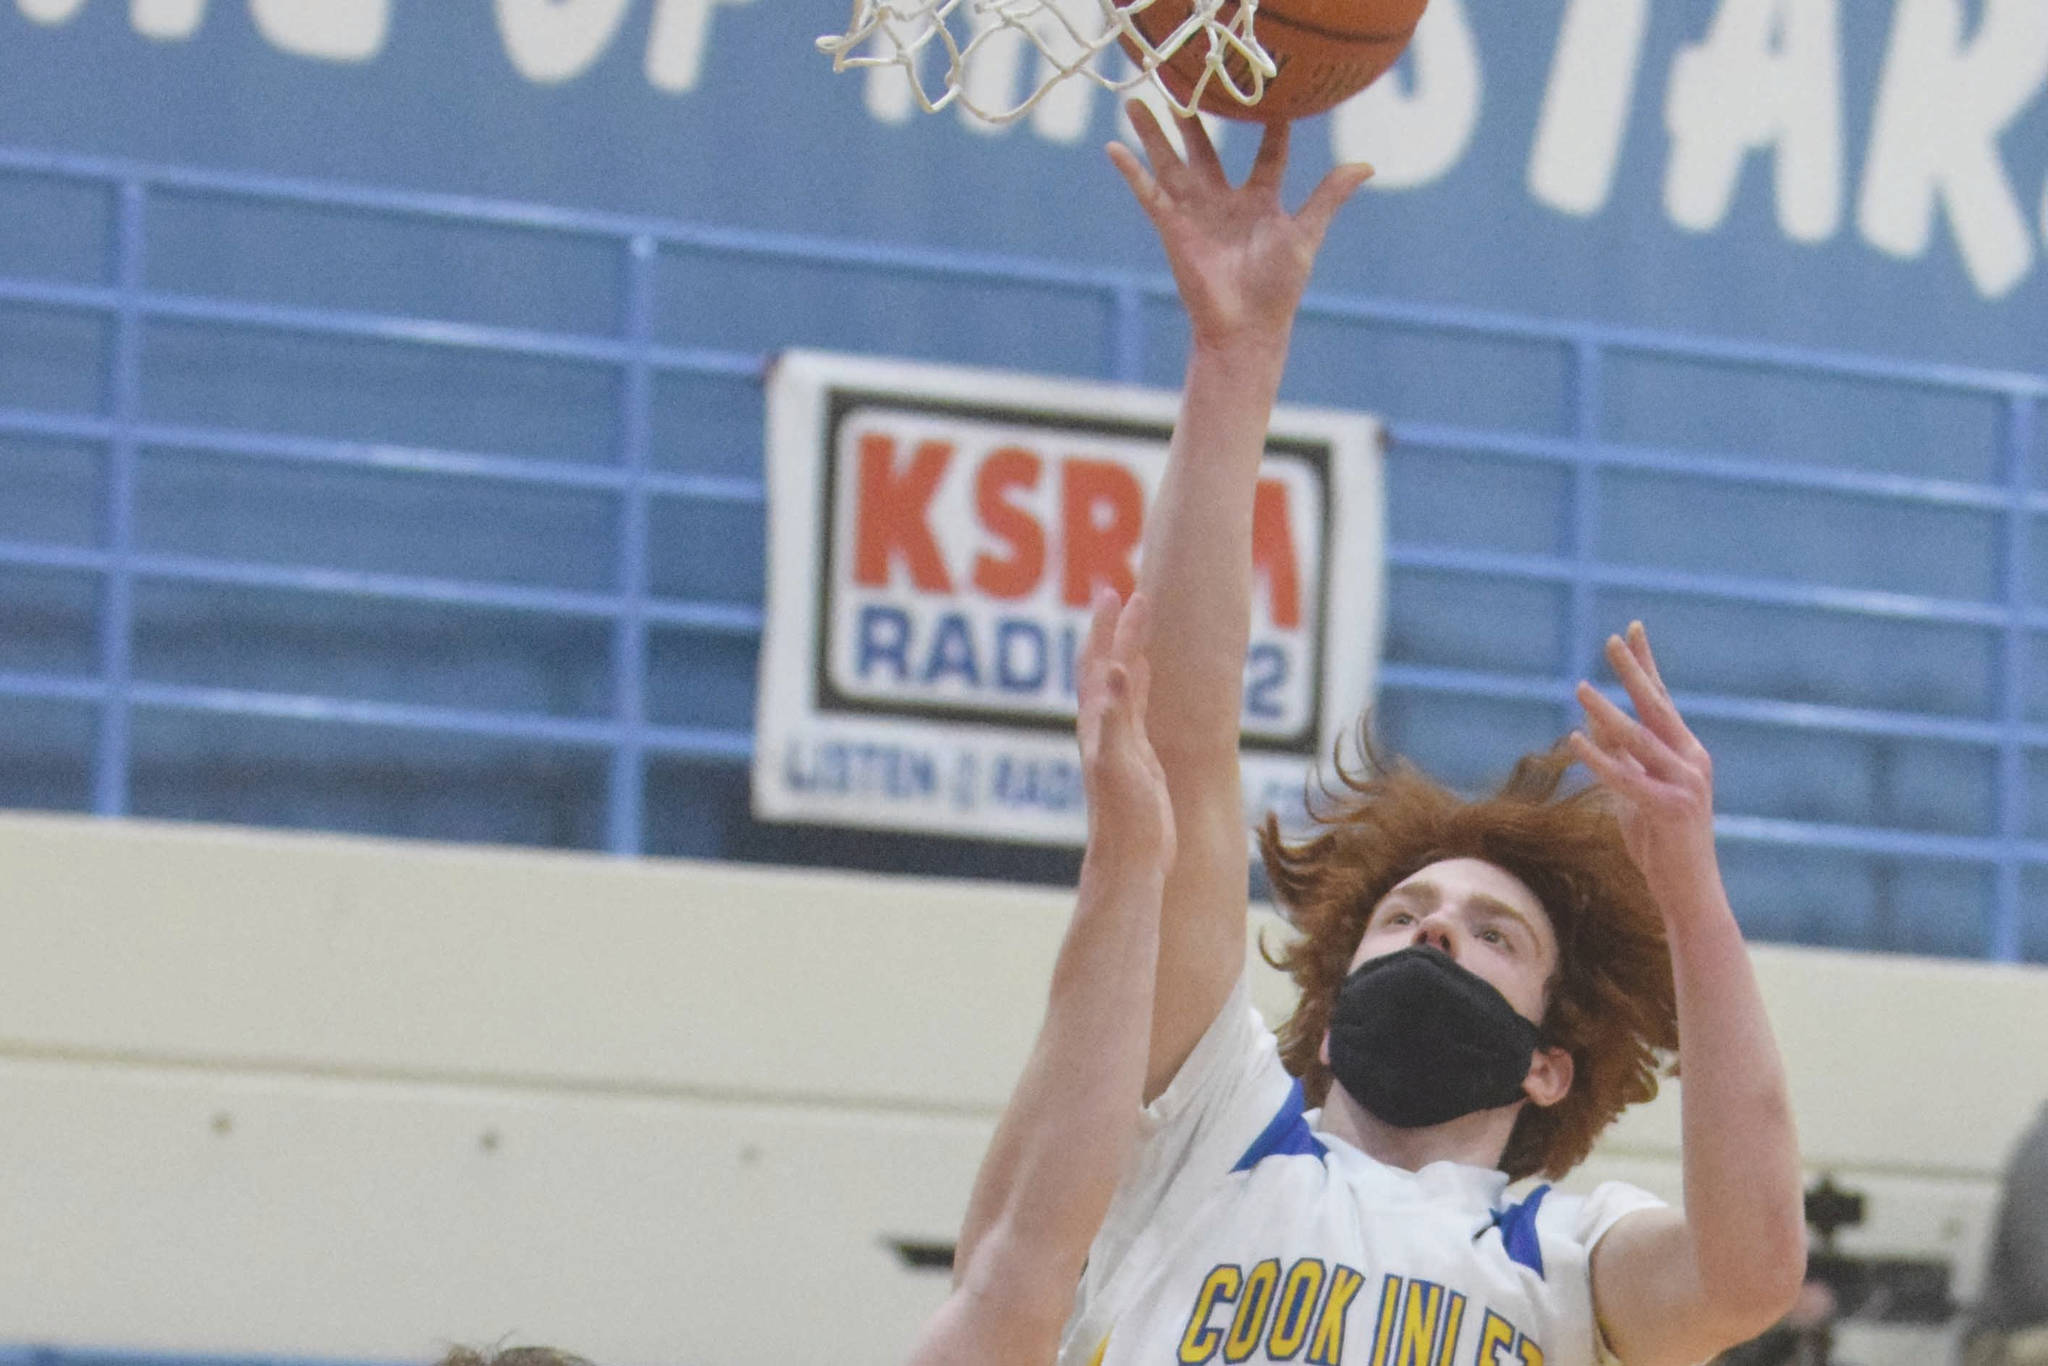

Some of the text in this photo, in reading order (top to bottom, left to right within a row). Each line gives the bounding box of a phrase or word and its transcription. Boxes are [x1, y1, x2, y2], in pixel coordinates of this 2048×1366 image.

[855, 605, 1288, 719] RADI 2
[1177, 1257, 1366, 1366] COOK
